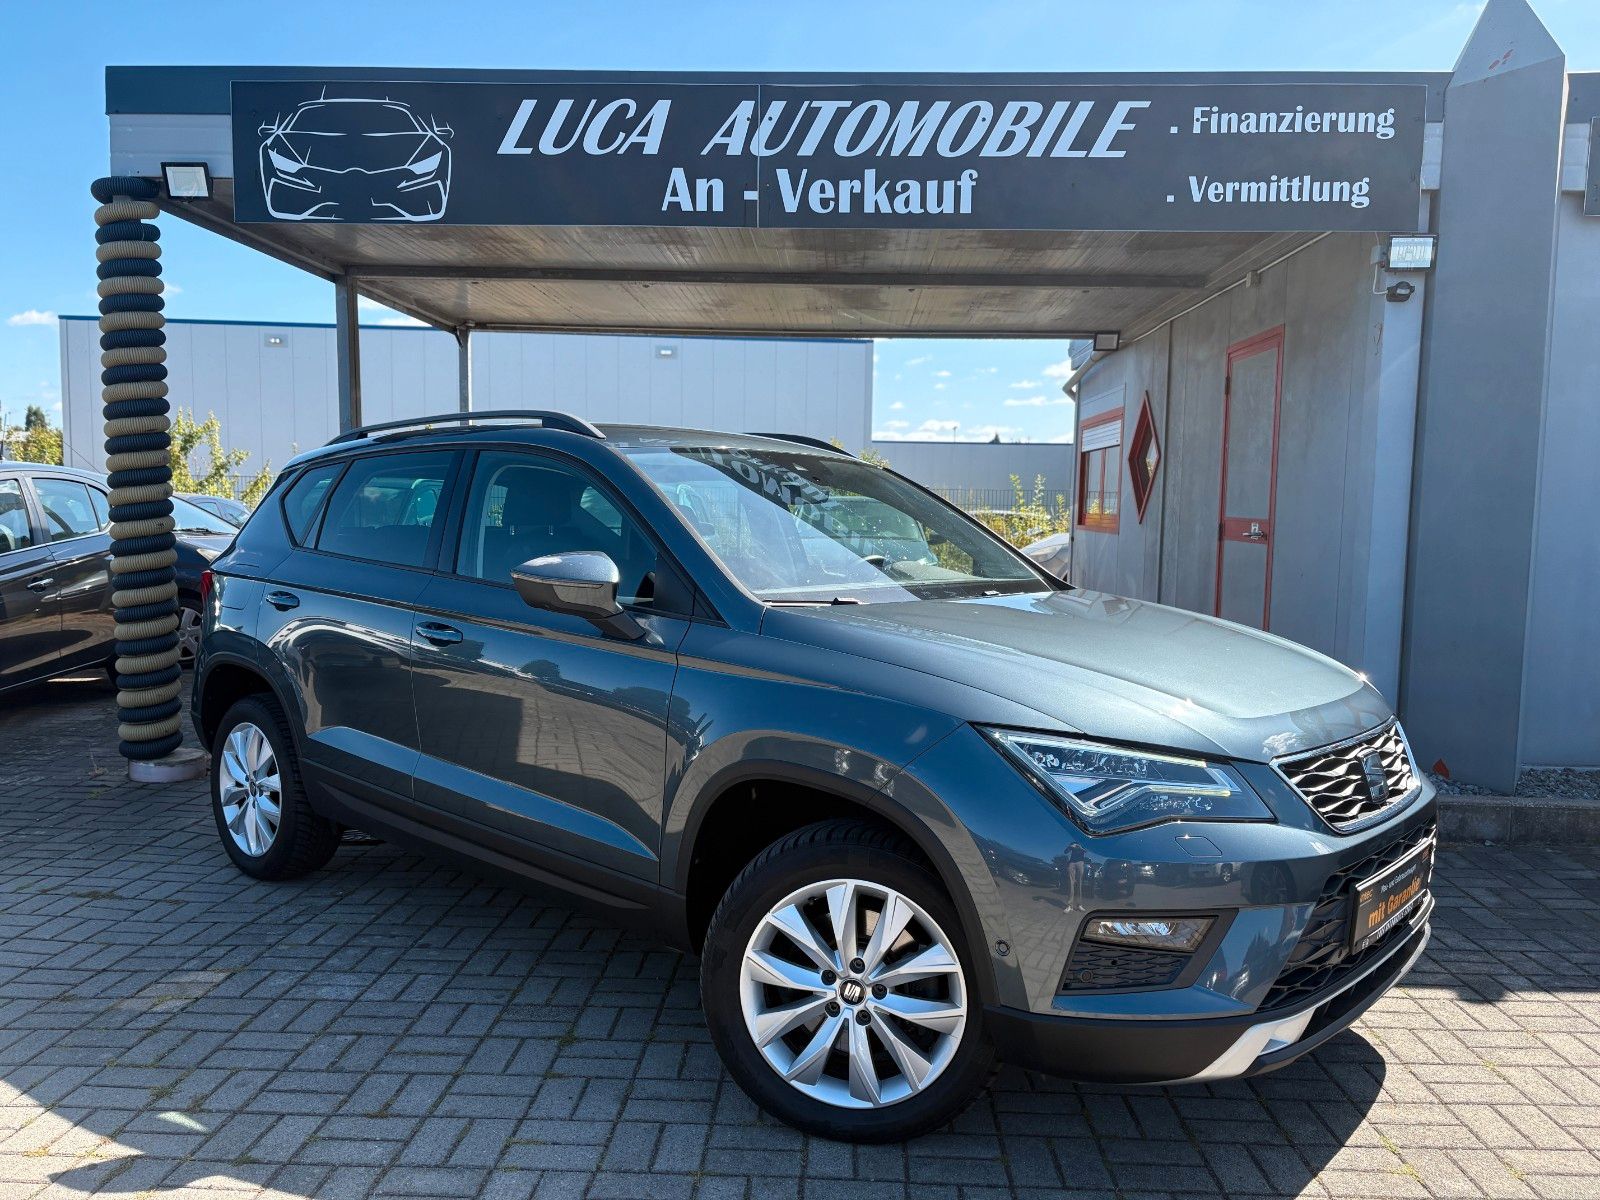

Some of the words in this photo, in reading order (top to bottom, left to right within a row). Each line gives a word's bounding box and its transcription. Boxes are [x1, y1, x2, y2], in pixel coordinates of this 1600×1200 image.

[496, 98, 672, 156] LUCA
[700, 99, 1151, 158] AUTOMOBILE
[1192, 105, 1396, 140] Finanzierung
[661, 167, 724, 212] An
[775, 168, 979, 214] Verkauf
[1188, 174, 1370, 209] Vermittlung
[1368, 901, 1386, 929] mit
[1387, 875, 1421, 914] Garantie
